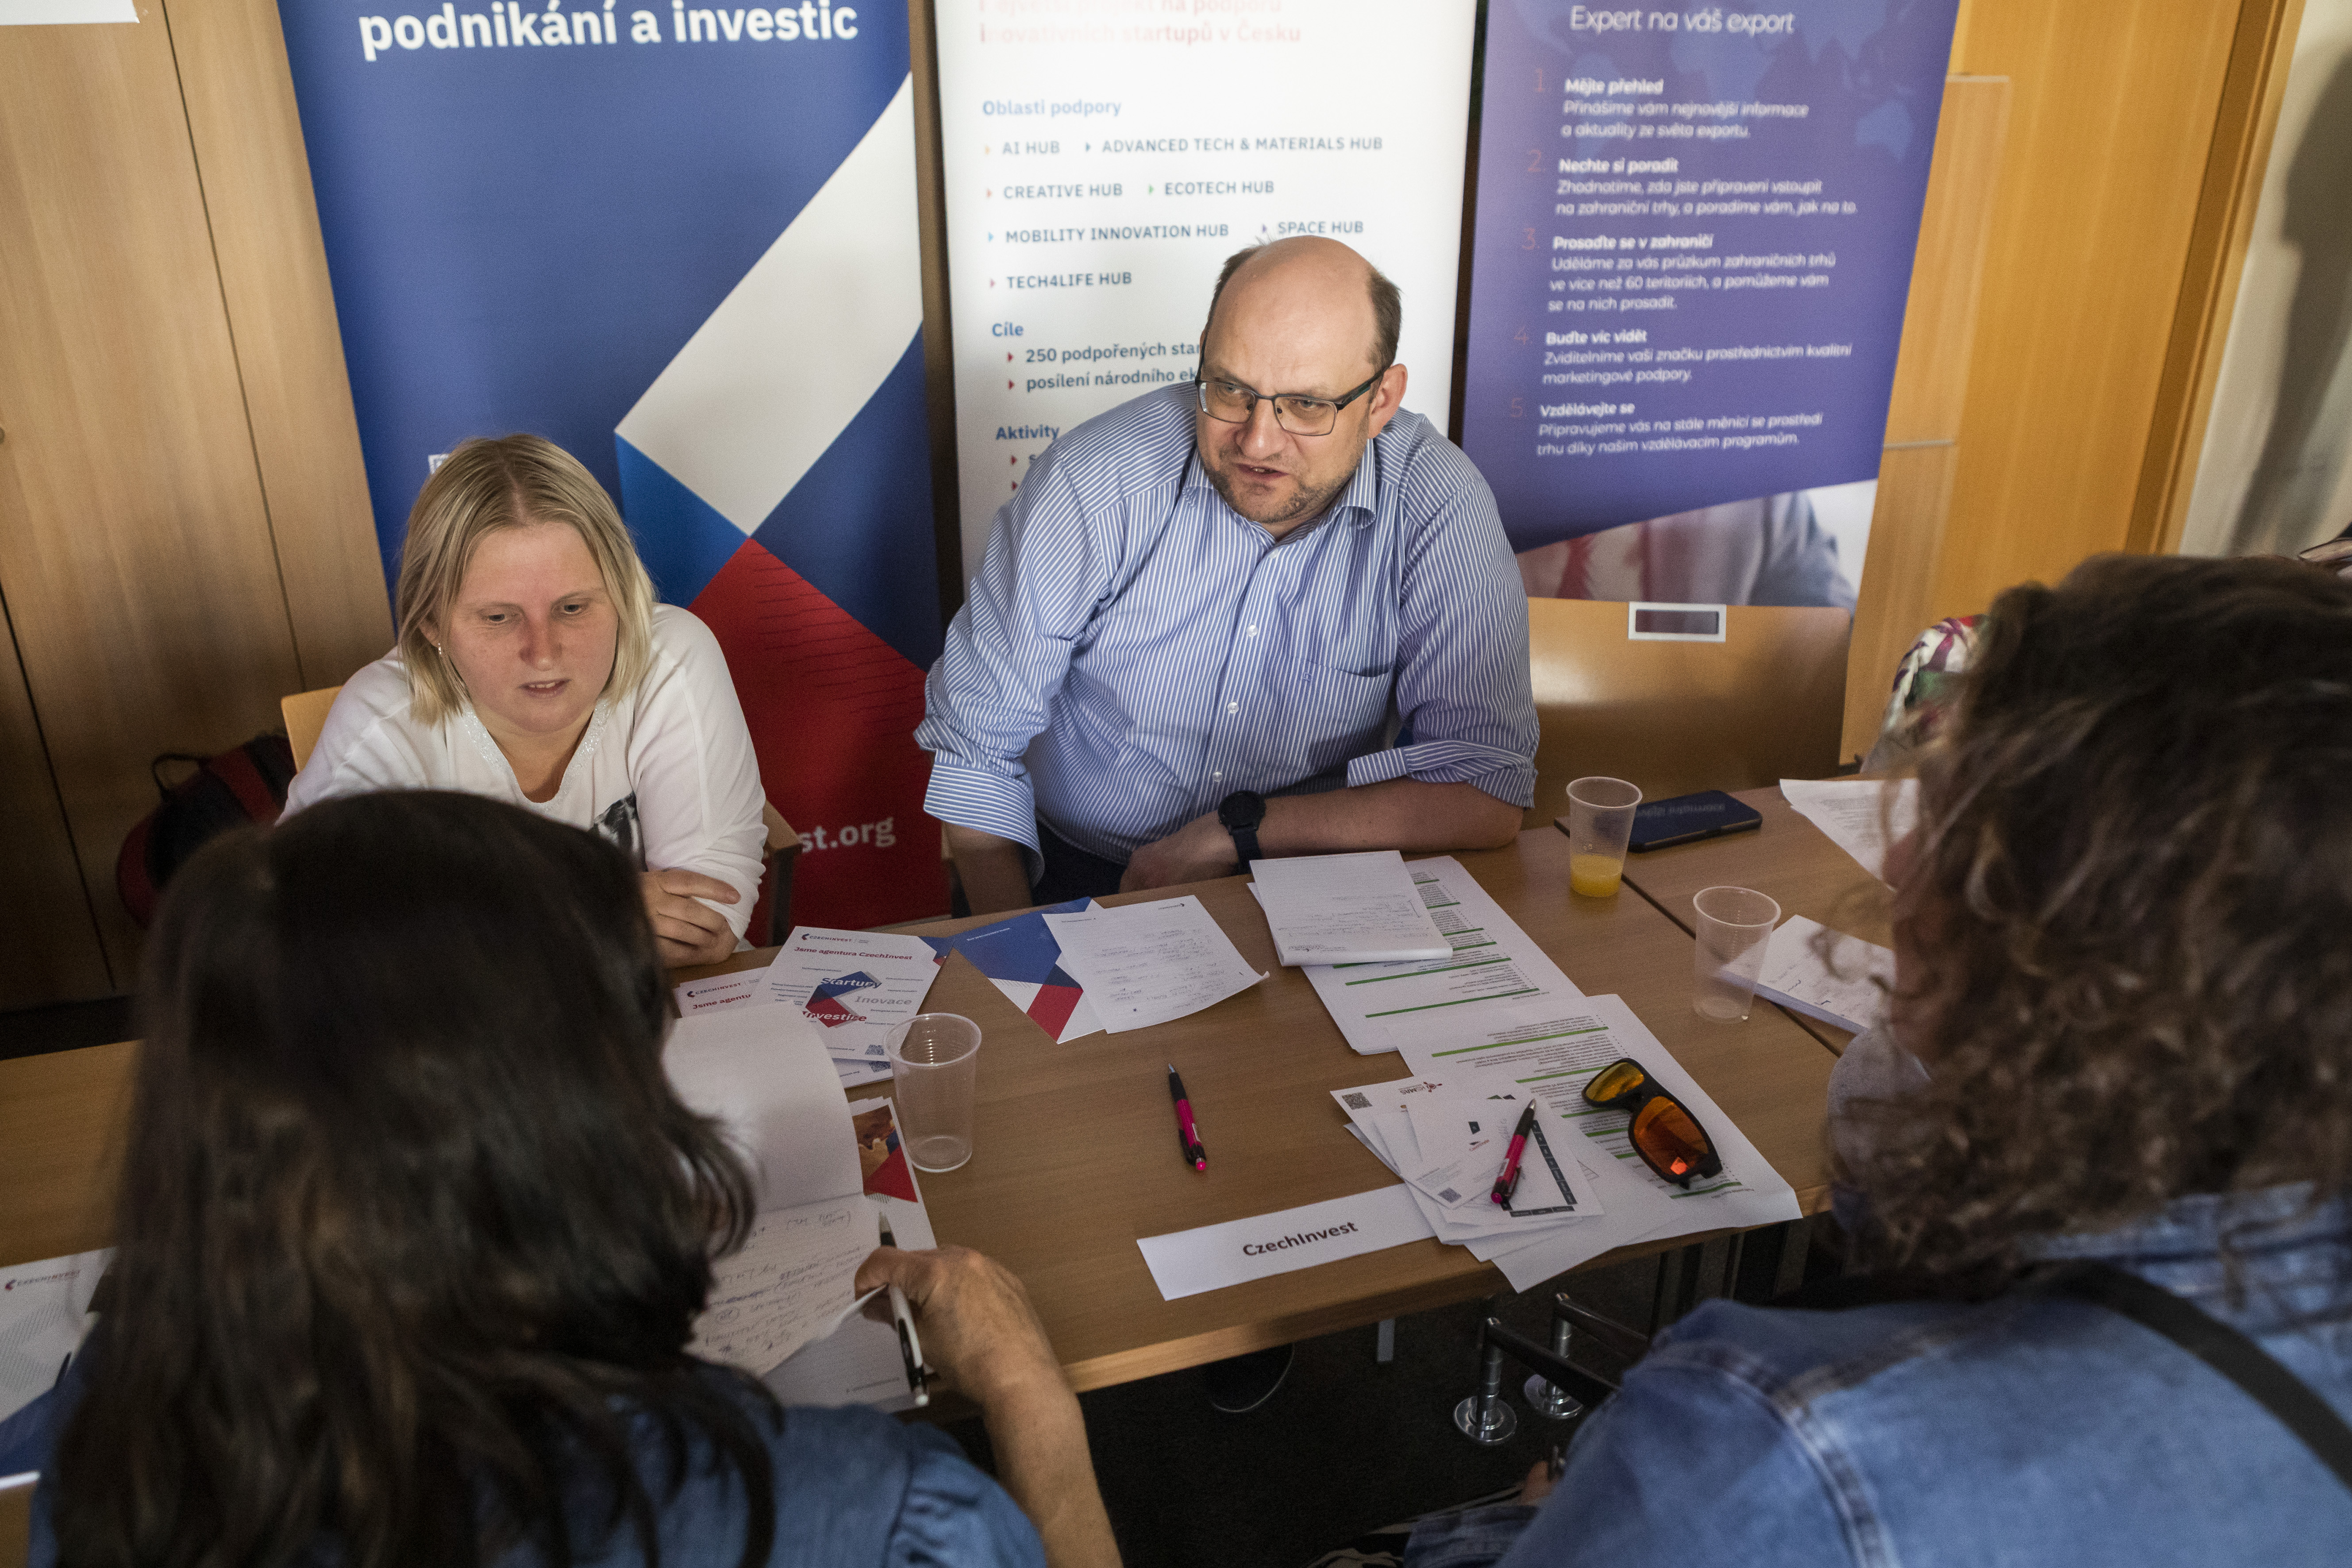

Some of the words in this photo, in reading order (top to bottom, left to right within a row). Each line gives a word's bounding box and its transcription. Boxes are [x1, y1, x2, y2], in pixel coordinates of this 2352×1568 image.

[1571, 5, 1643, 35] Expert
[1648, 12, 1678, 31] na
[1684, 7, 1722, 33] váš
[1727, 12, 1795, 37] export
[359, 0, 617, 62] podnikání
[630, 10, 662, 43] a
[671, 0, 858, 43] investic
[1122, 20, 1213, 46] startupů
[1220, 28, 1230, 41] v
[1237, 18, 1301, 42] Česku
[1607, 77, 1664, 96] přehled
[982, 99, 1045, 116] Oblasti
[1051, 99, 1122, 119] podpory
[1740, 101, 1809, 118] informace
[1574, 122, 1637, 140] aktuality
[1003, 141, 1020, 155] AI
[1025, 141, 1060, 154] HUB
[1102, 139, 1189, 153] ADVANCED
[1195, 138, 1235, 152] TECH
[1240, 138, 1250, 150] &
[1256, 137, 1345, 150] MATERIALS
[1350, 136, 1383, 150] HUB
[1559, 158, 1610, 173] Nechte
[1612, 157, 1625, 173] si
[1626, 157, 1679, 176] poradit
[1003, 184, 1084, 199] CREATIVE
[1089, 183, 1123, 196] HUB
[1165, 181, 1236, 196] ECOTECH
[1242, 180, 1274, 194] HUB
[1555, 202, 1575, 216] na
[1682, 201, 1693, 215] a
[1820, 201, 1840, 214] na
[1006, 227, 1085, 243] MOBILITY
[1091, 224, 1191, 241] INNOVATION
[1196, 223, 1229, 237] HUB
[1278, 221, 1326, 235] SPACE
[1331, 220, 1364, 233] HUB
[1552, 235, 1617, 251] Prosaďte
[1619, 237, 1636, 250] se
[1638, 237, 1649, 249] v
[1649, 234, 1714, 250] zahraničí
[1616, 258, 1633, 270] za
[1006, 273, 1094, 289] TECH4LIFE
[1099, 271, 1132, 285] HUB
[1549, 280, 1567, 291] ve
[1598, 275, 1623, 291] než
[1624, 275, 1644, 290] 60
[1711, 276, 1722, 289] a
[1547, 300, 1564, 313] se
[1566, 299, 1586, 312] na
[1588, 296, 1617, 312] nich
[992, 322, 1024, 337] Cíle
[1545, 330, 1588, 346] Buďte
[1613, 328, 1648, 344] vidět
[1026, 348, 1057, 363] 250
[1061, 342, 1167, 364] podpořených
[1655, 347, 1703, 362] značku
[1026, 371, 1091, 393] posílení
[1095, 368, 1175, 386] národního
[1542, 369, 1634, 386] marketingové
[1540, 402, 1617, 418] Vzdělávejte
[1619, 403, 1636, 415] se
[996, 424, 1060, 440] Aktivity
[1653, 421, 1671, 433] na
[1751, 416, 1766, 429] se
[1537, 443, 1564, 457] trhu
[819, 948, 857, 956] agentura
[859, 952, 913, 960] CzechInvest
[695, 982, 741, 995] CZECHINVEST
[820, 977, 882, 989] Startupy
[693, 1001, 718, 1009] Jsme
[855, 996, 912, 1005] Inovace
[1243, 1221, 1359, 1256] CzechInvest
